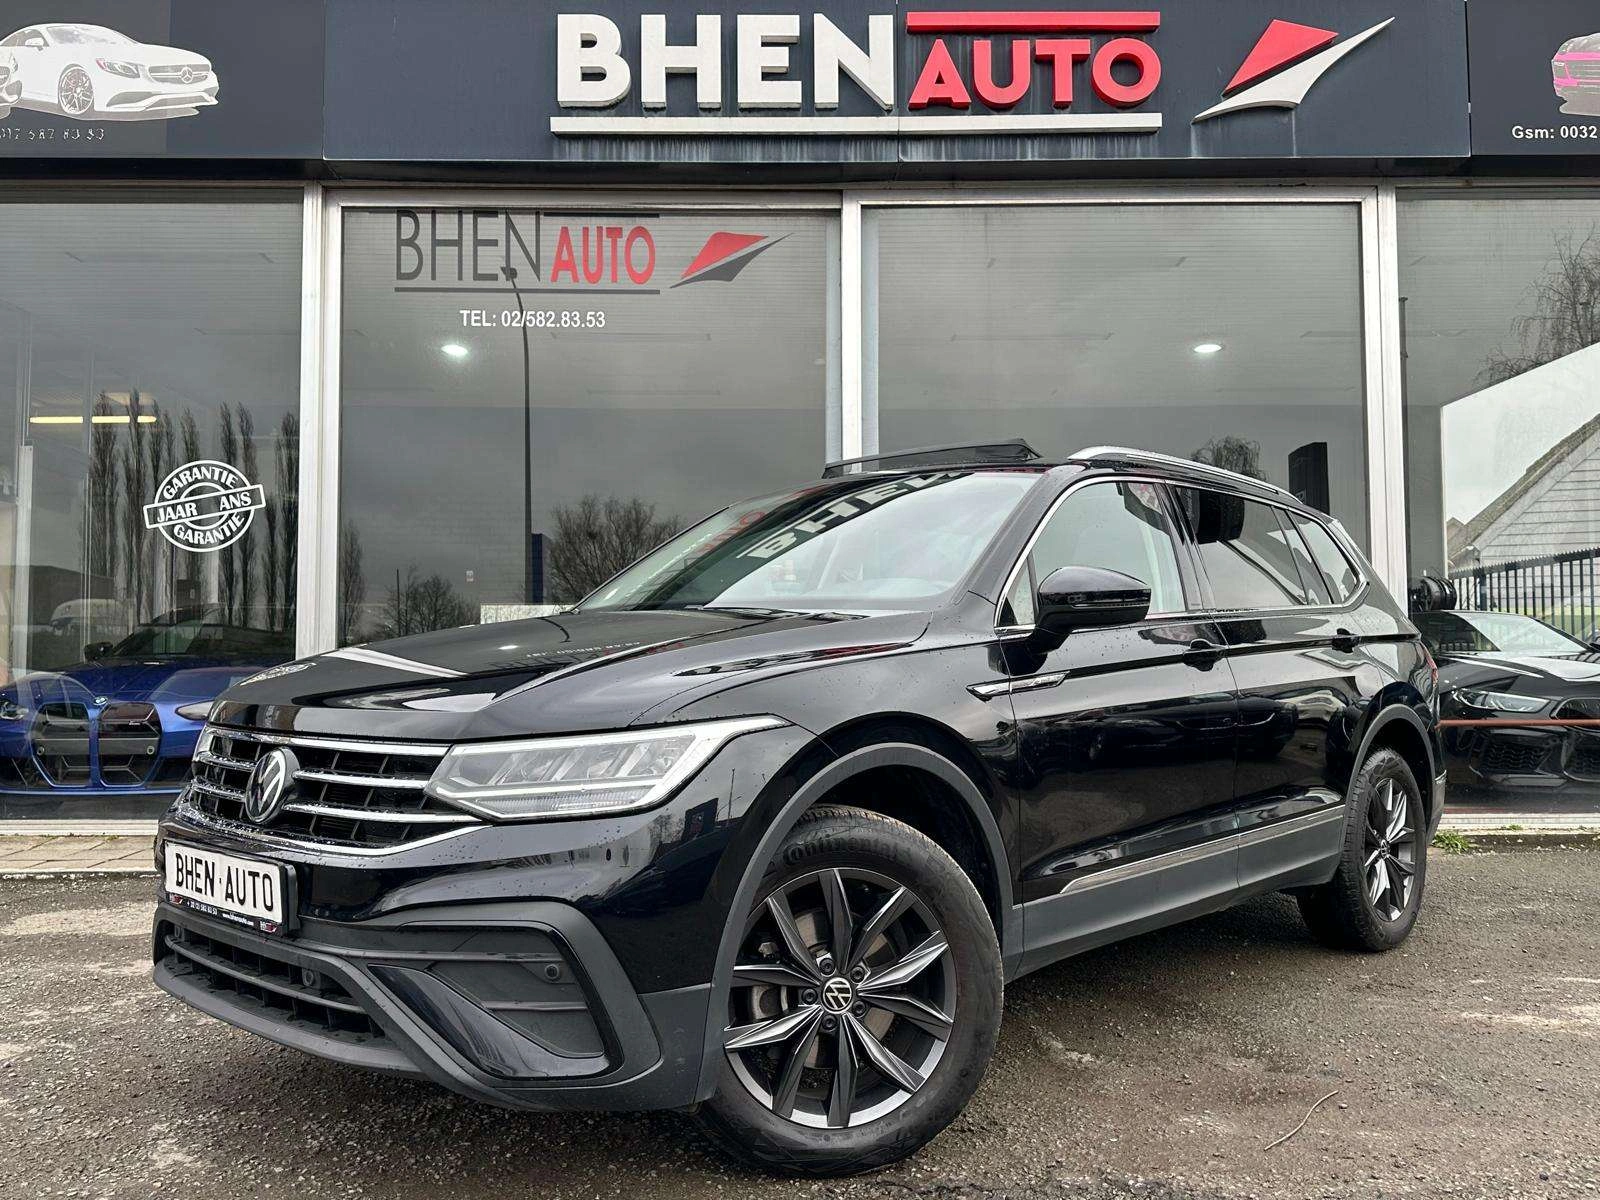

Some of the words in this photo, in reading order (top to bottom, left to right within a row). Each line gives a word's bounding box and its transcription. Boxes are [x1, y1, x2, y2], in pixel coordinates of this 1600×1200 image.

[557, 13, 894, 110] BHEN
[908, 37, 1162, 110] AUTO
[1511, 125, 1555, 139] Gsm:
[1560, 125, 1598, 139] 0032
[396, 209, 541, 282] BHEN
[550, 225, 656, 285] AUTO
[460, 309, 497, 327] TEL:
[500, 309, 606, 328] 02/582.83.53
[162, 466, 239, 500] GARANTIE
[157, 502, 198, 523] JAAR
[219, 491, 252, 511] ANS
[173, 511, 245, 545] GARANTIE
[175, 852, 215, 897] BHEN
[225, 865, 274, 912] AUTO
